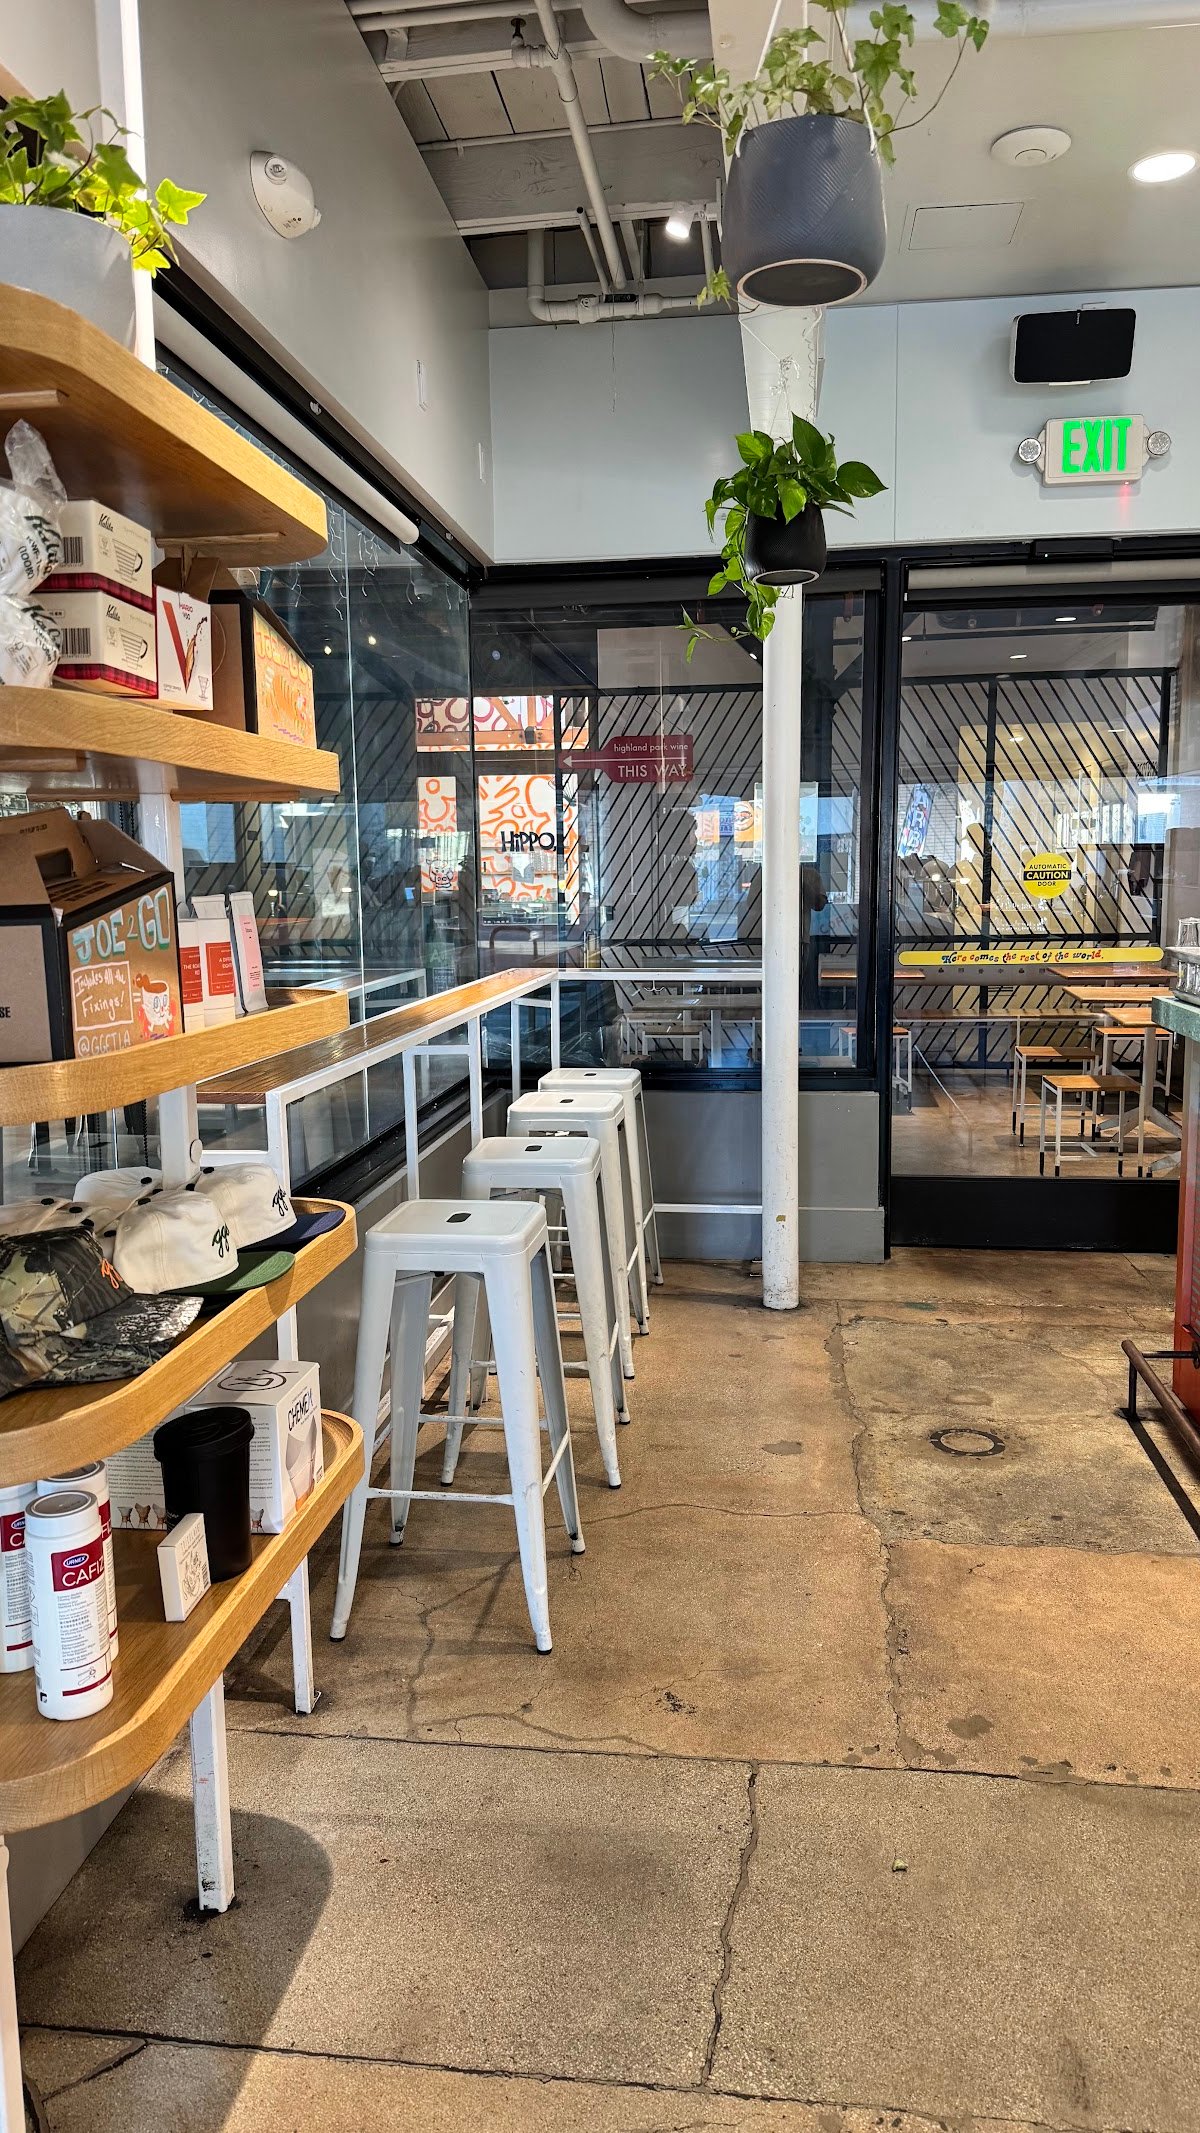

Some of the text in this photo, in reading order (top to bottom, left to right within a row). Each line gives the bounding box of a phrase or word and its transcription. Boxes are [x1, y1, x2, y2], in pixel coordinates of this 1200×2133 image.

[1062, 417, 1133, 473] EXIT
[614, 743, 689, 753] highland park wine
[618, 764, 687, 778] THIS WAY
[1026, 870, 1069, 880] CAUTION
[73, 886, 171, 965] JOE 2 GO
[942, 949, 1104, 964] Here comes the rest of the world.
[75, 969, 103, 998] Includes
[115, 968, 126, 985] the
[82, 990, 125, 1021] Fixings!
[288, 1388, 314, 1432] CHEMEX
[65, 1555, 86, 1567] URNEX
